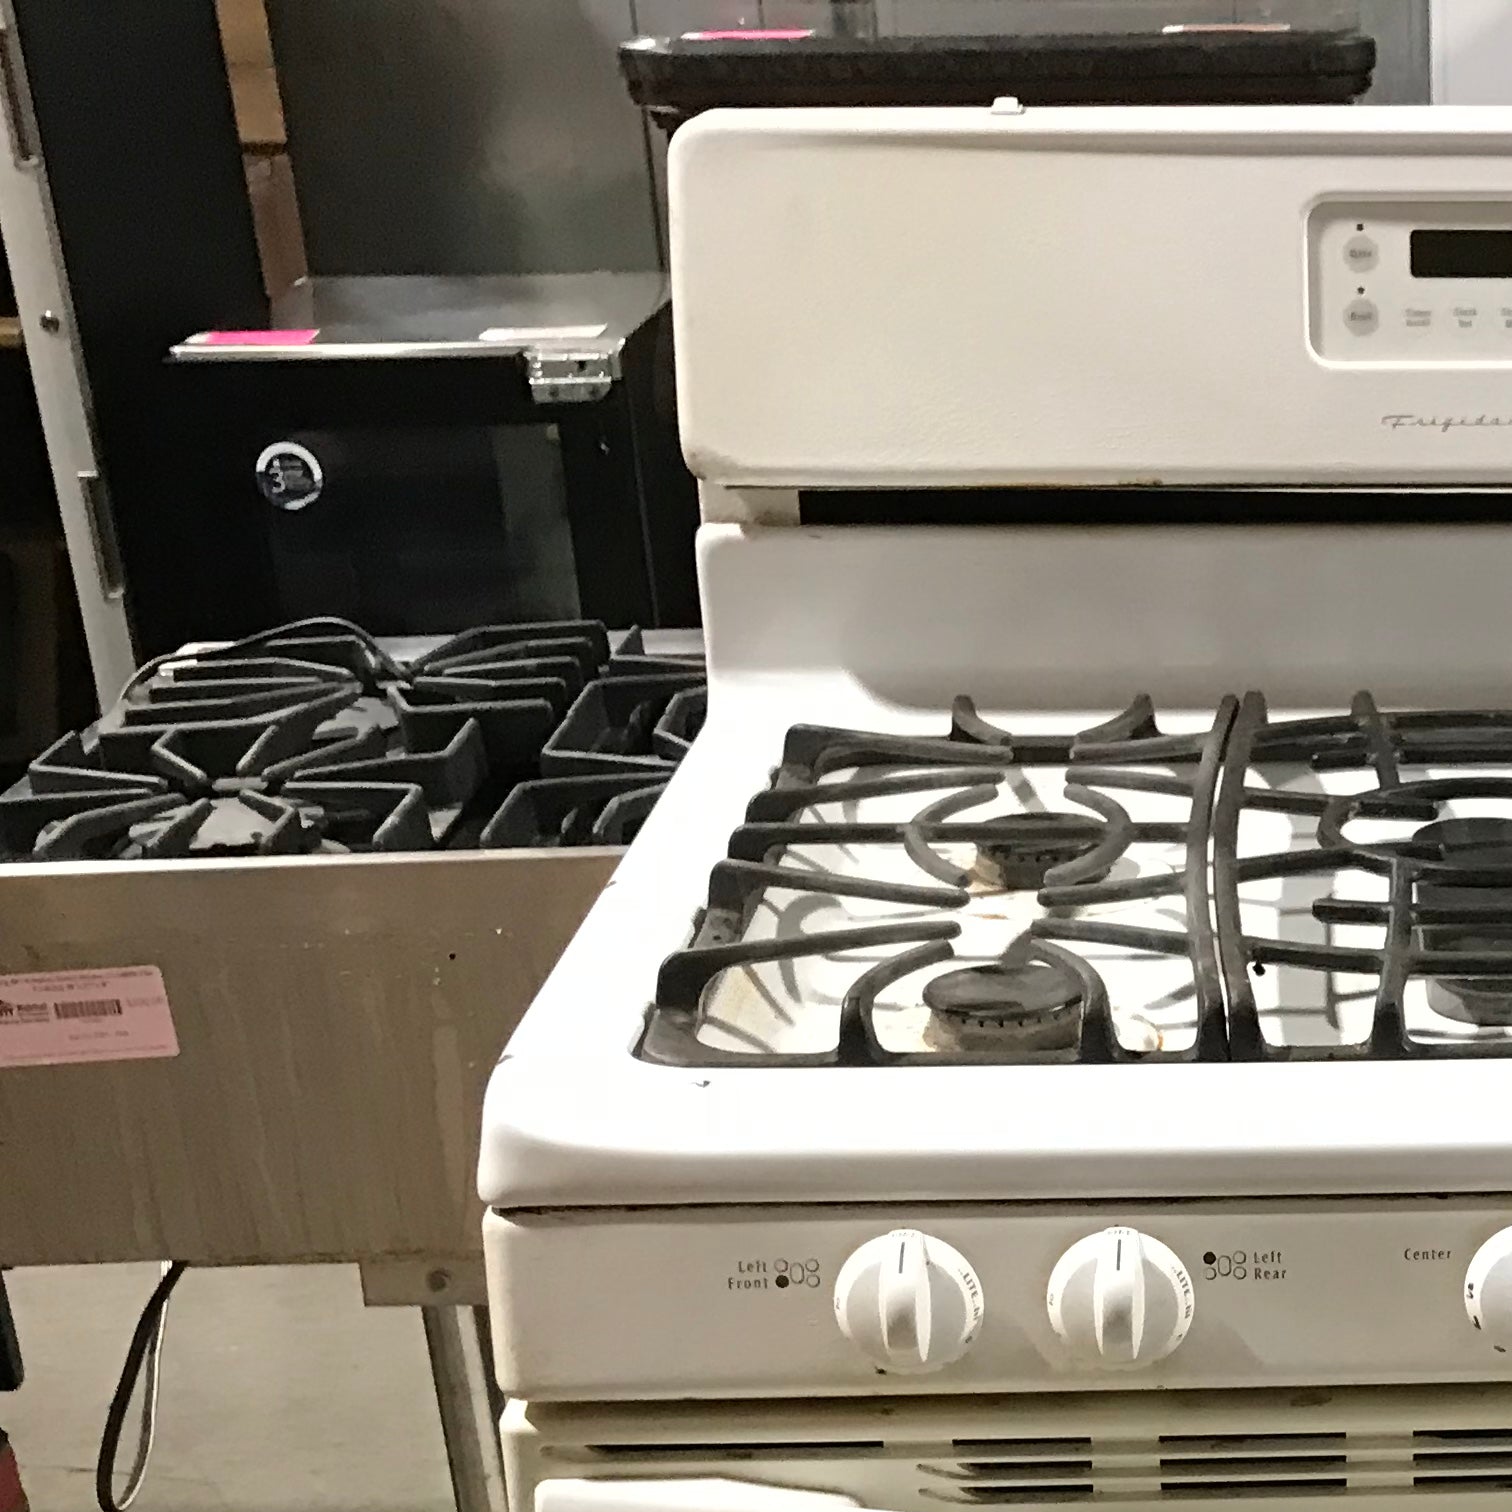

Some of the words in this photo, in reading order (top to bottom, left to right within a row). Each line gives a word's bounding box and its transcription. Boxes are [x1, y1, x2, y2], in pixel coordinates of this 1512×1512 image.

[1253, 1250, 1282, 1264] Left
[1404, 1248, 1451, 1260] Center
[738, 1261, 767, 1273] Left
[1254, 1267, 1286, 1280] Rear
[728, 1277, 767, 1289] Front
